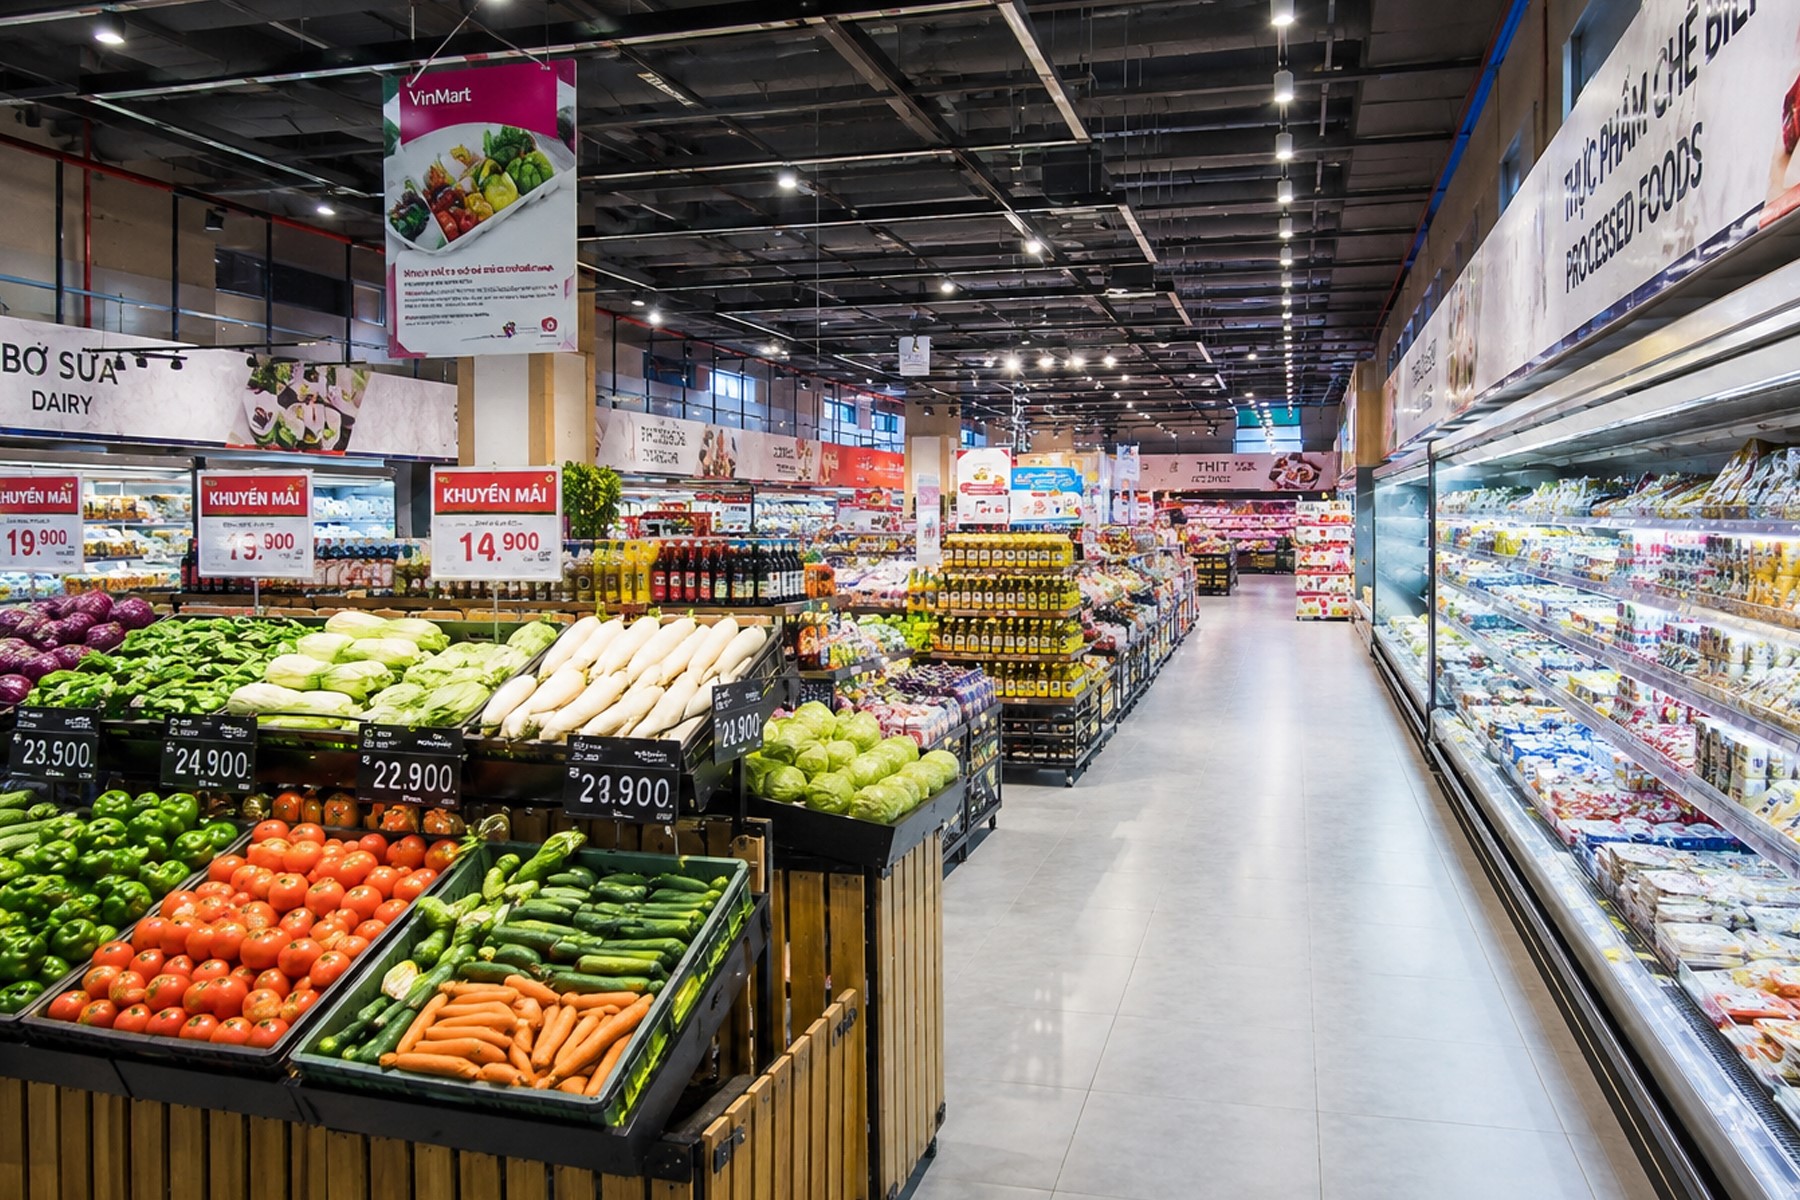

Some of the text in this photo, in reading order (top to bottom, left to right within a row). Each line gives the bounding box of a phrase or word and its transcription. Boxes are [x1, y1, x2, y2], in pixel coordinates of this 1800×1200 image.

[409, 87, 472, 107] VinMart
[1566, 121, 1703, 294] PROCESSED FOODS
[32, 390, 93, 415] DAIRY
